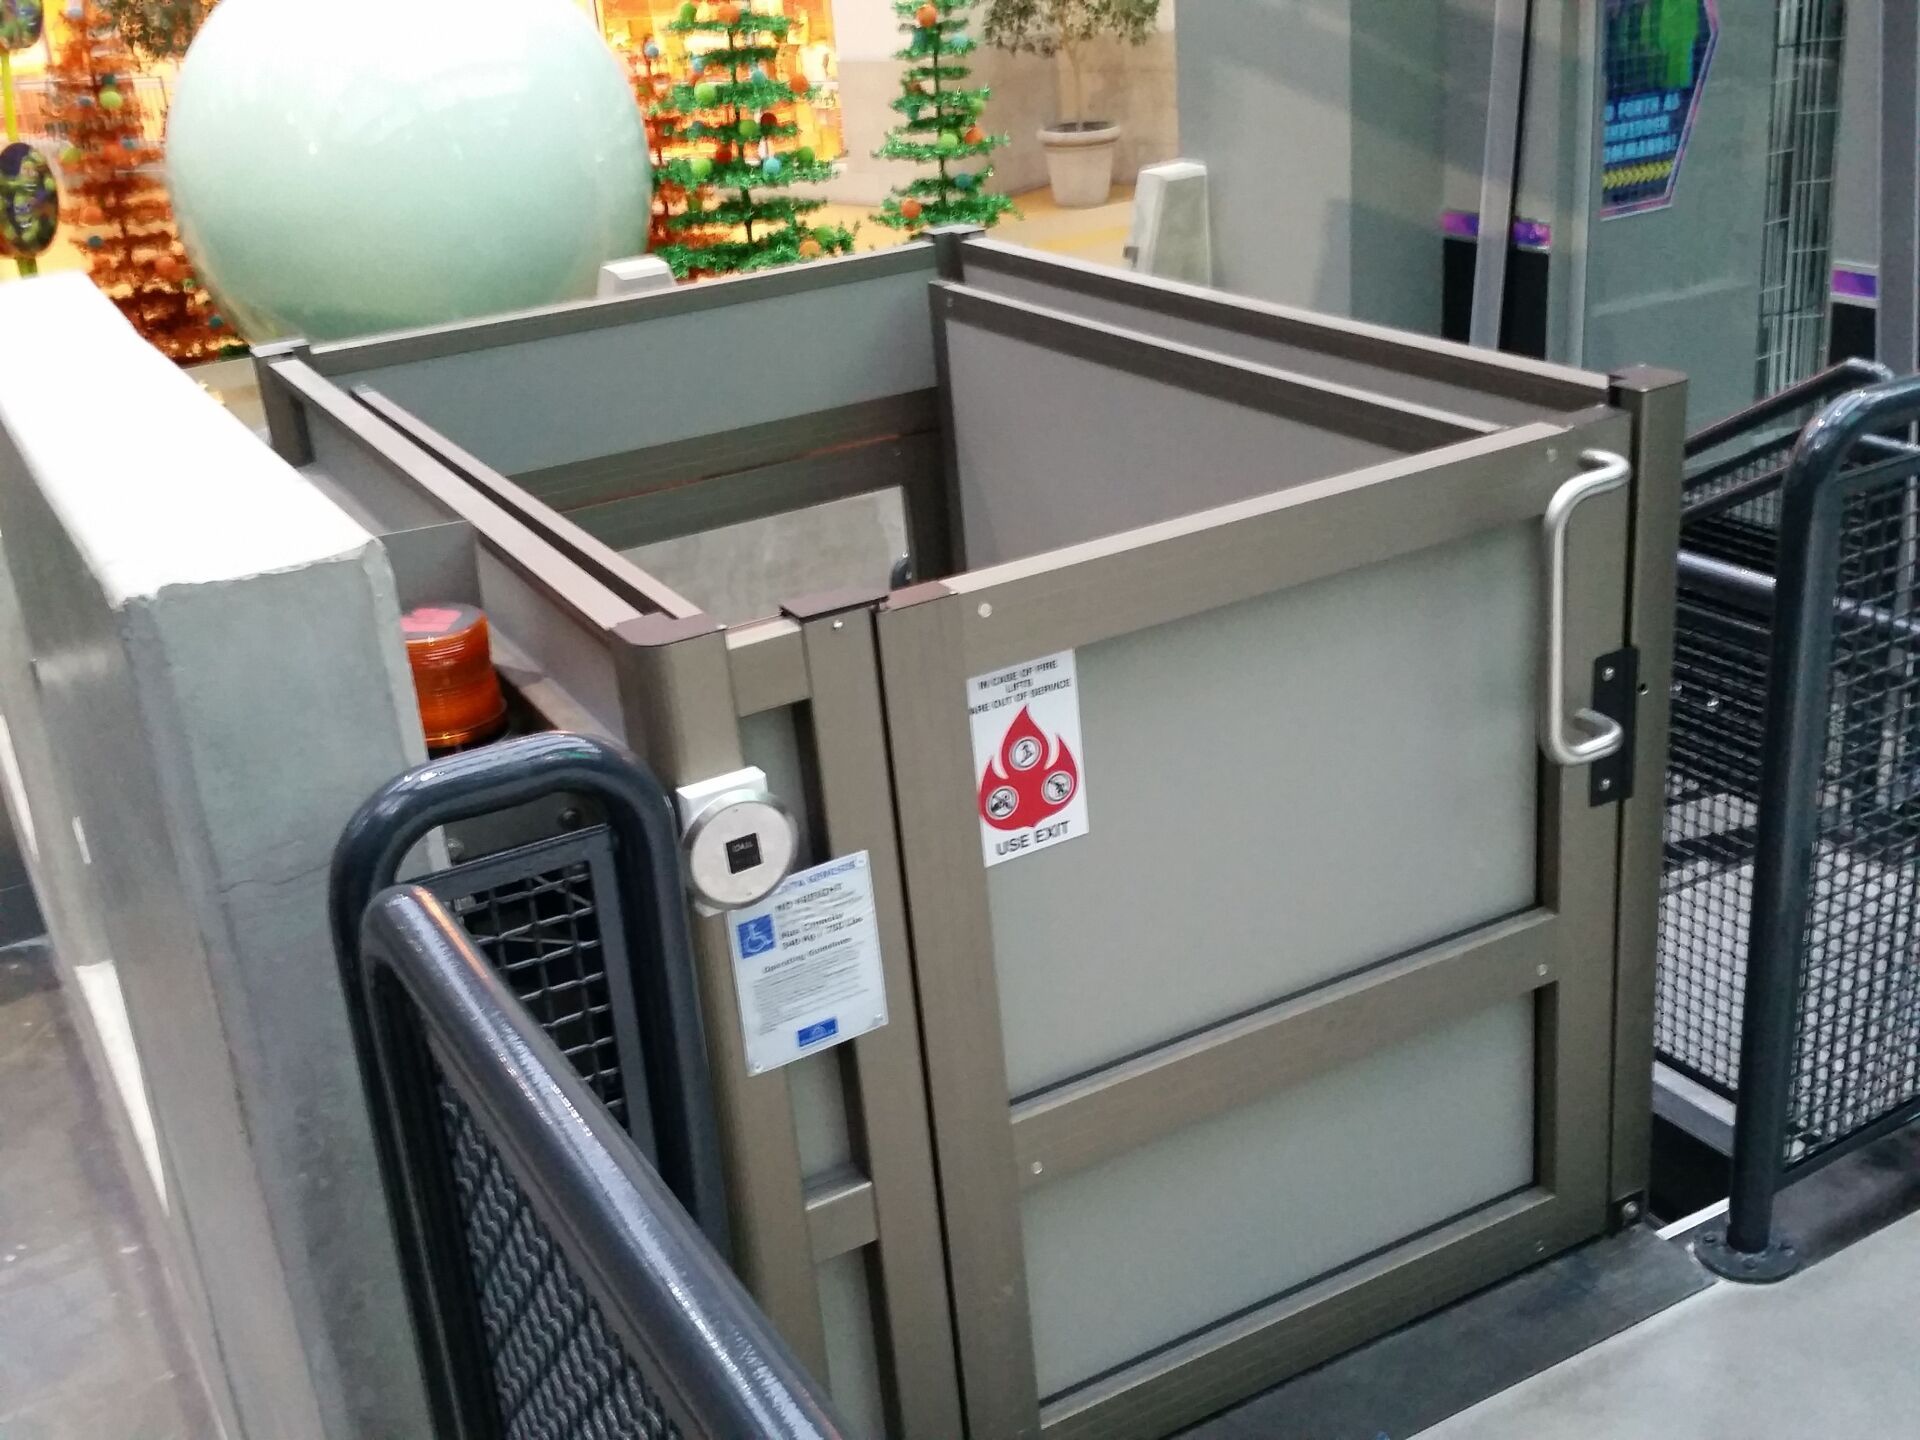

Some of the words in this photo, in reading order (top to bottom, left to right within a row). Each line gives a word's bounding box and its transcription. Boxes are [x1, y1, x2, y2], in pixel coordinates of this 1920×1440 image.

[993, 671, 1018, 686] CASE
[1021, 667, 1033, 677] OF
[1036, 660, 1058, 671] FIRE
[993, 696, 1012, 708] OUT
[1015, 692, 1028, 702] OF
[1031, 678, 1071, 697] SERVICE
[996, 834, 1029, 855] USE
[1035, 820, 1070, 844] EXIT
[763, 954, 806, 974] Operating
